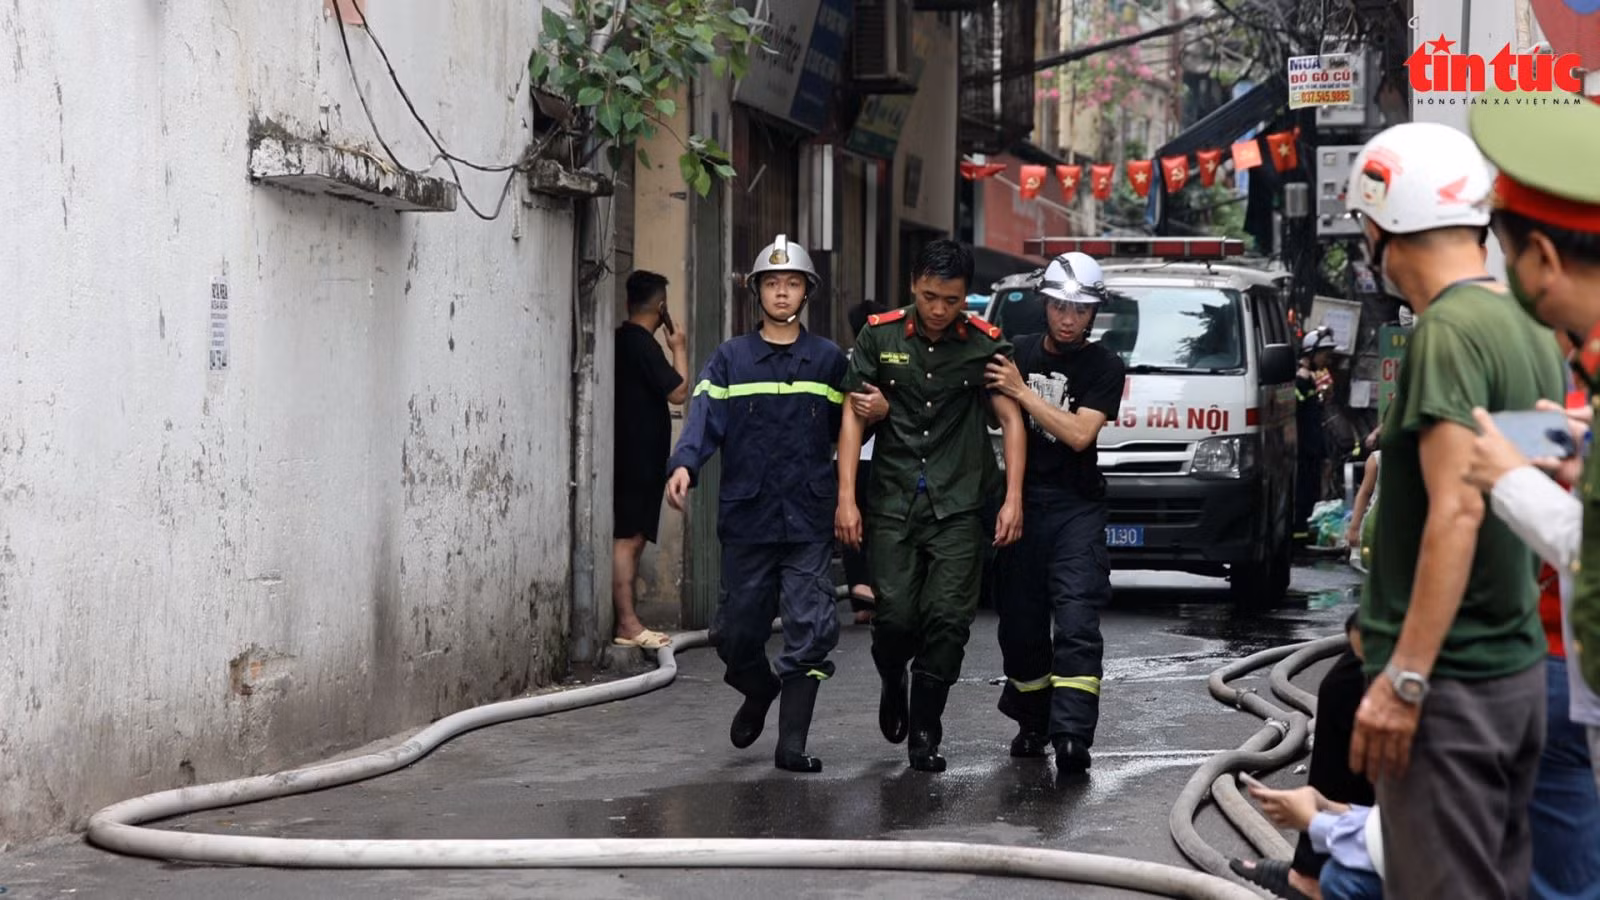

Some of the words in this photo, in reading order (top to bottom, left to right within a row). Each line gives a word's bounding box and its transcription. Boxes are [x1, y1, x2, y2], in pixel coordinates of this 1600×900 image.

[1290, 59, 1321, 70] MUA
[1147, 402, 1179, 429] HÀ
[1187, 404, 1229, 435] NỘI
